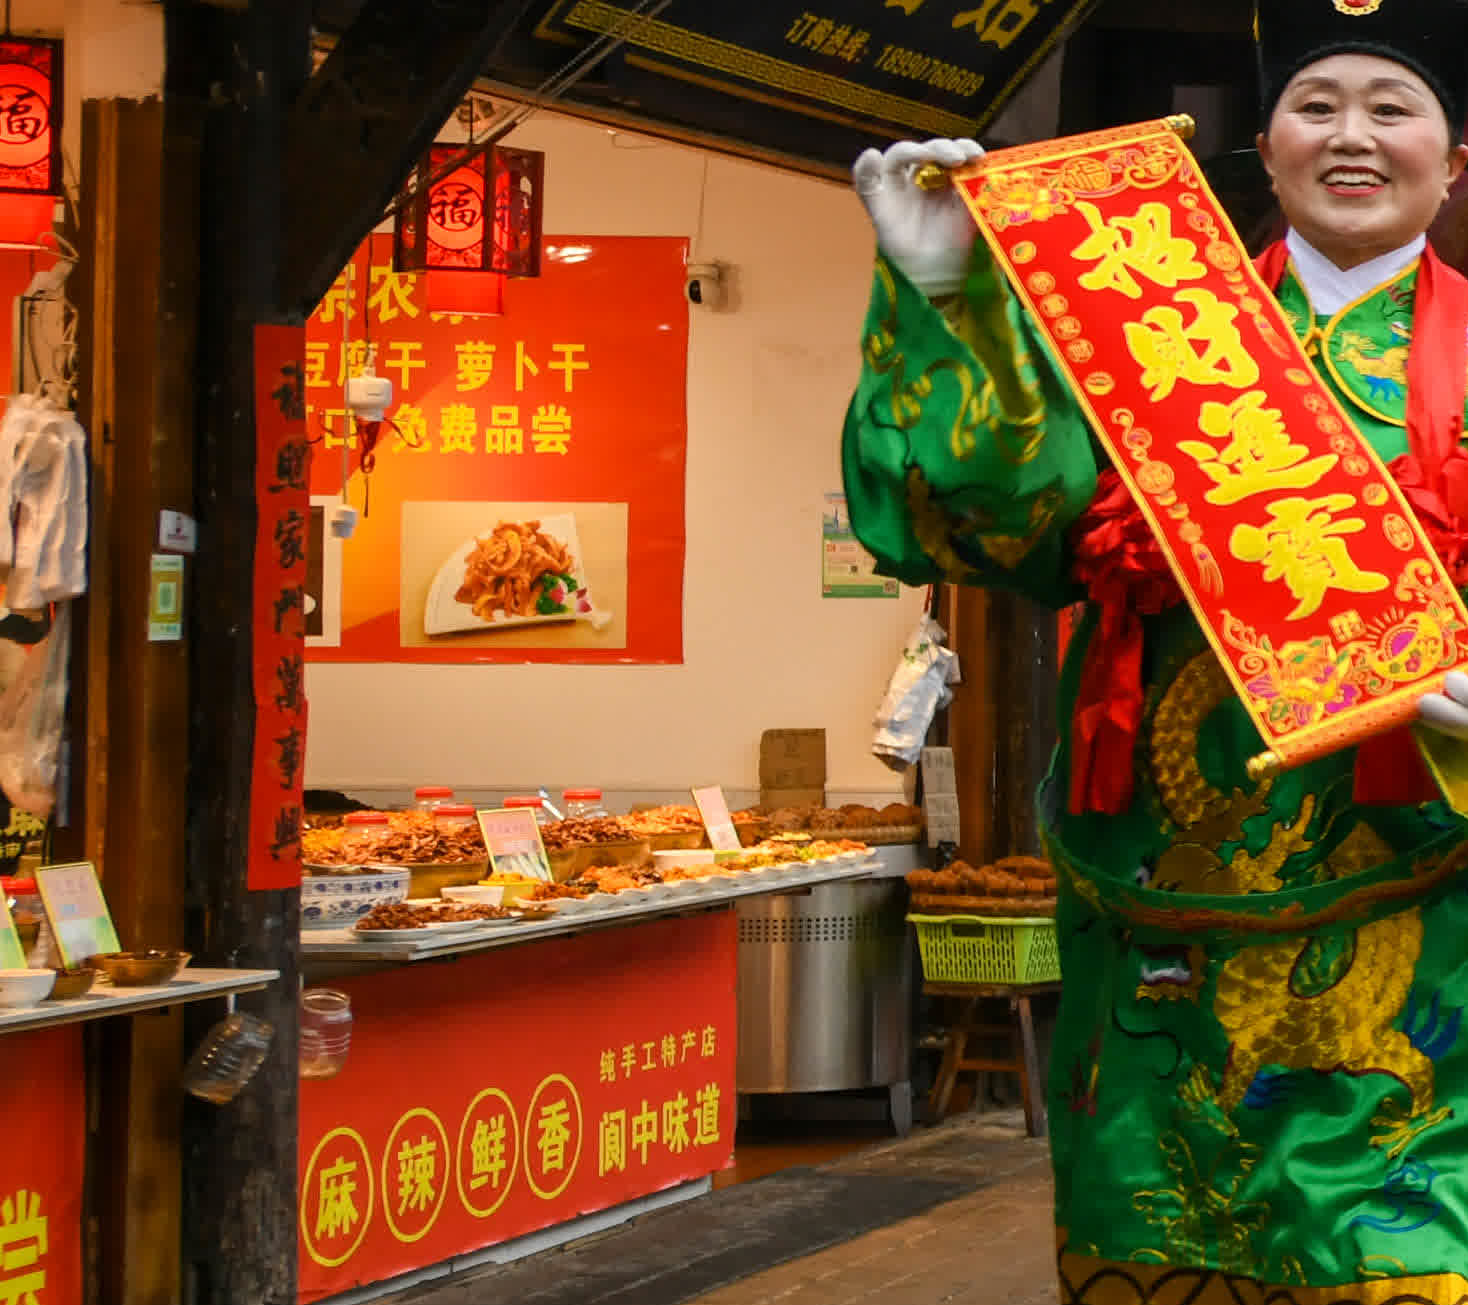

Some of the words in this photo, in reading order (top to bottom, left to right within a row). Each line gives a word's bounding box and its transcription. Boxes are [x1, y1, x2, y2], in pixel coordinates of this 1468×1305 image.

[431, 187, 477, 226] 福
[455, 340, 589, 392] 萝卜干
[392, 402, 572, 456] 免费品尝
[1070, 201, 1390, 620] 招財進寶
[600, 1024, 716, 1083] 纯手工特产店
[599, 1082, 720, 1177] 阆中味道
[315, 1099, 571, 1240] 麻辣鲜香
